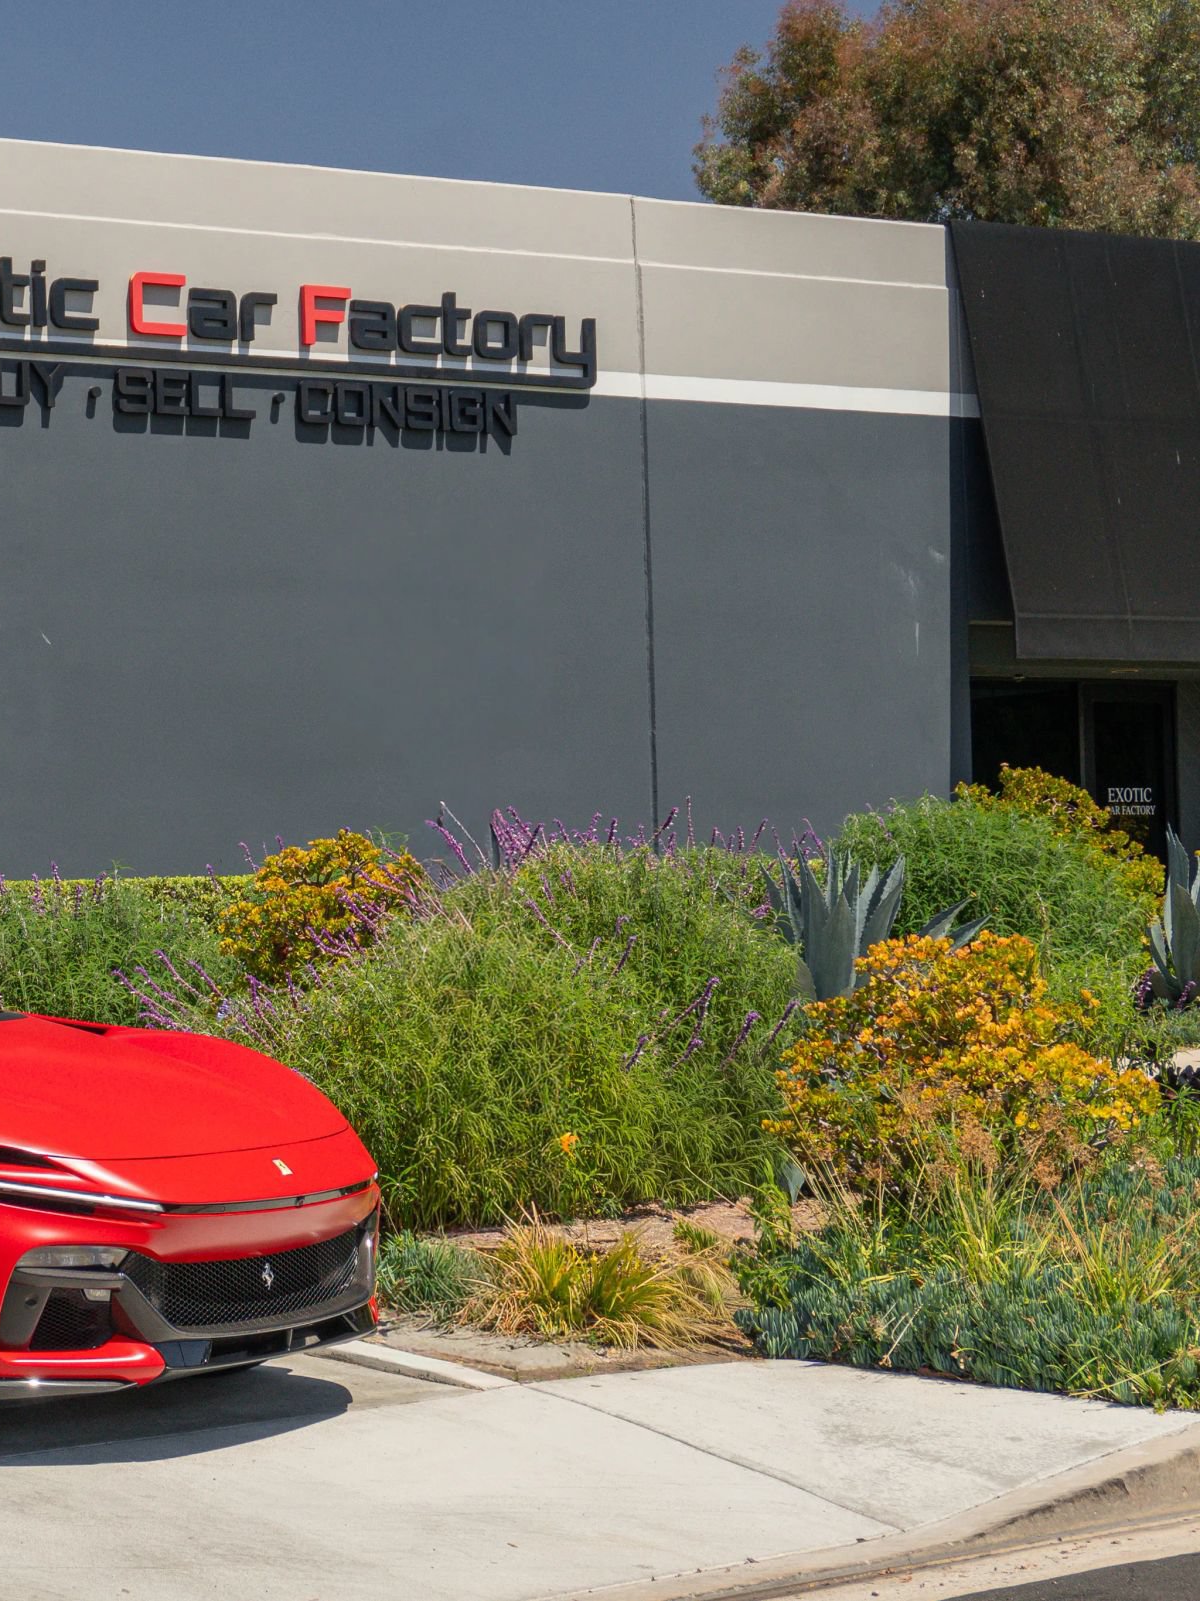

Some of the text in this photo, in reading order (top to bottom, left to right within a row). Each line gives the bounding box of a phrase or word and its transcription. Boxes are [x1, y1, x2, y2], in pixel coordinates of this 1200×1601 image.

[129, 271, 278, 342] Car
[300, 284, 597, 389] Factory
[115, 367, 257, 419] SELL
[298, 379, 518, 437] CONSIGN
[1107, 787, 1153, 803] EXOTIC
[1109, 805, 1156, 816] AR FACTORY
